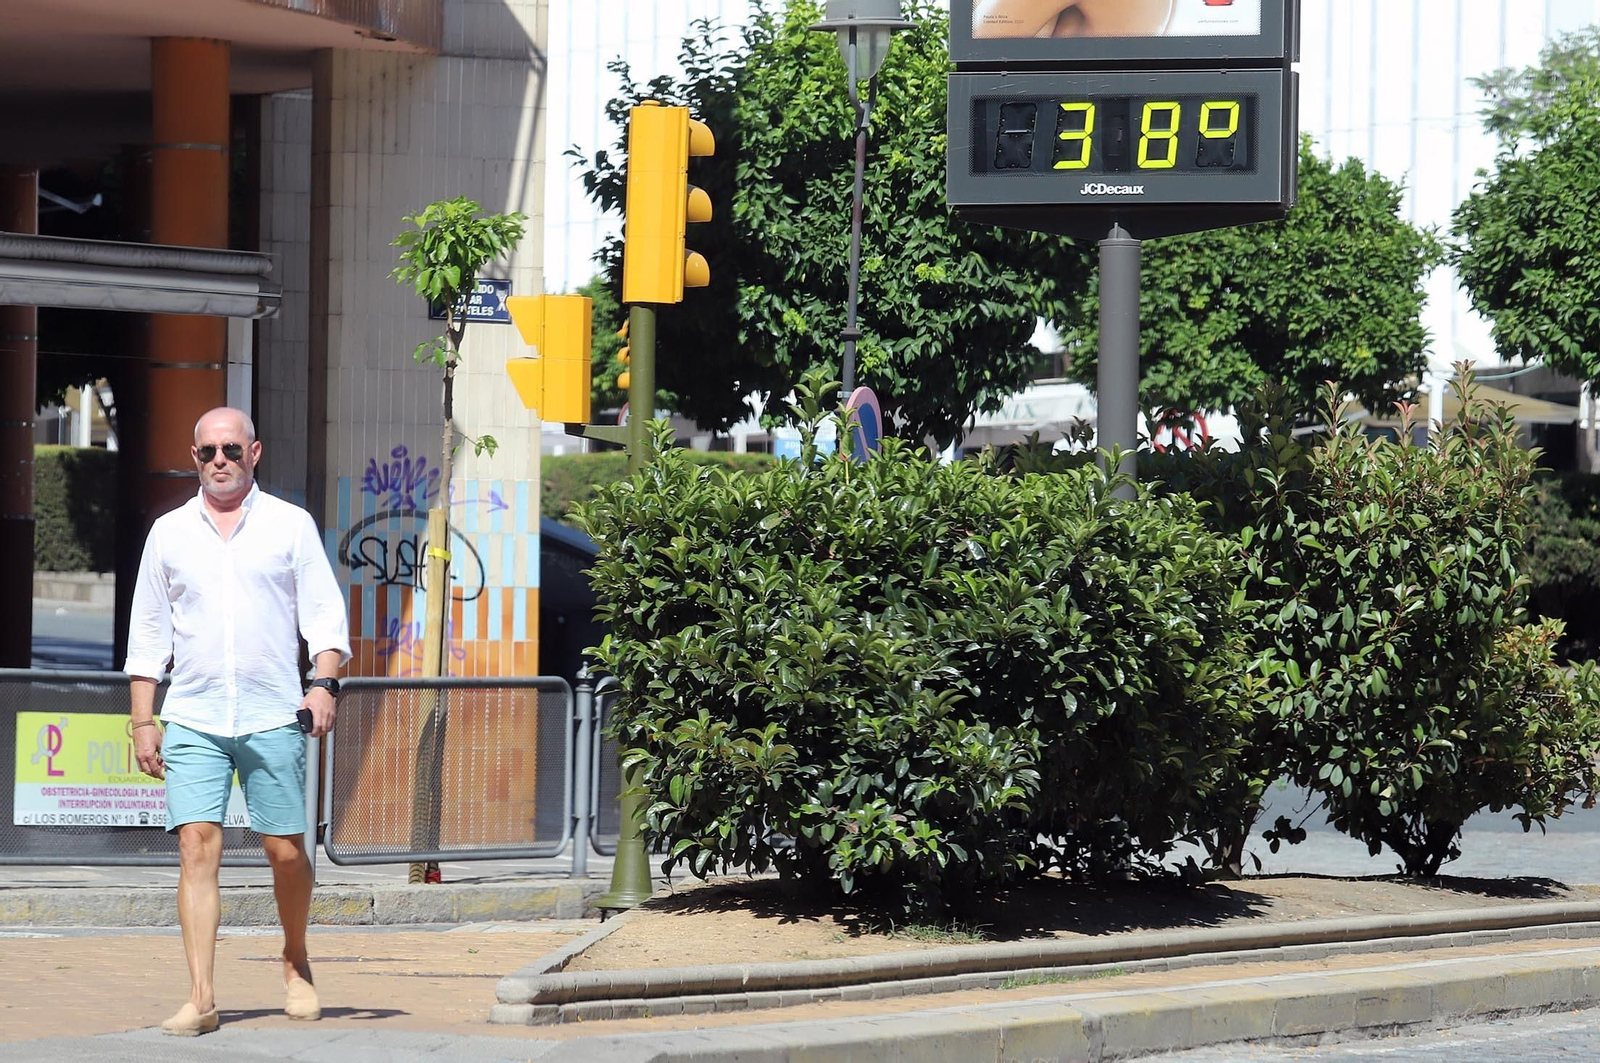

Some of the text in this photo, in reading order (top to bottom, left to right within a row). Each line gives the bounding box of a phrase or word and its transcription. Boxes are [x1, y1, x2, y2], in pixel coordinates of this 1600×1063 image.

[1080, 183, 1145, 196] JCDecaux
[113, 800, 157, 810] VOLUNTARIA
[35, 814, 56, 825] LOS
[59, 814, 109, 825] ROMEROS
[124, 814, 134, 825] 10
